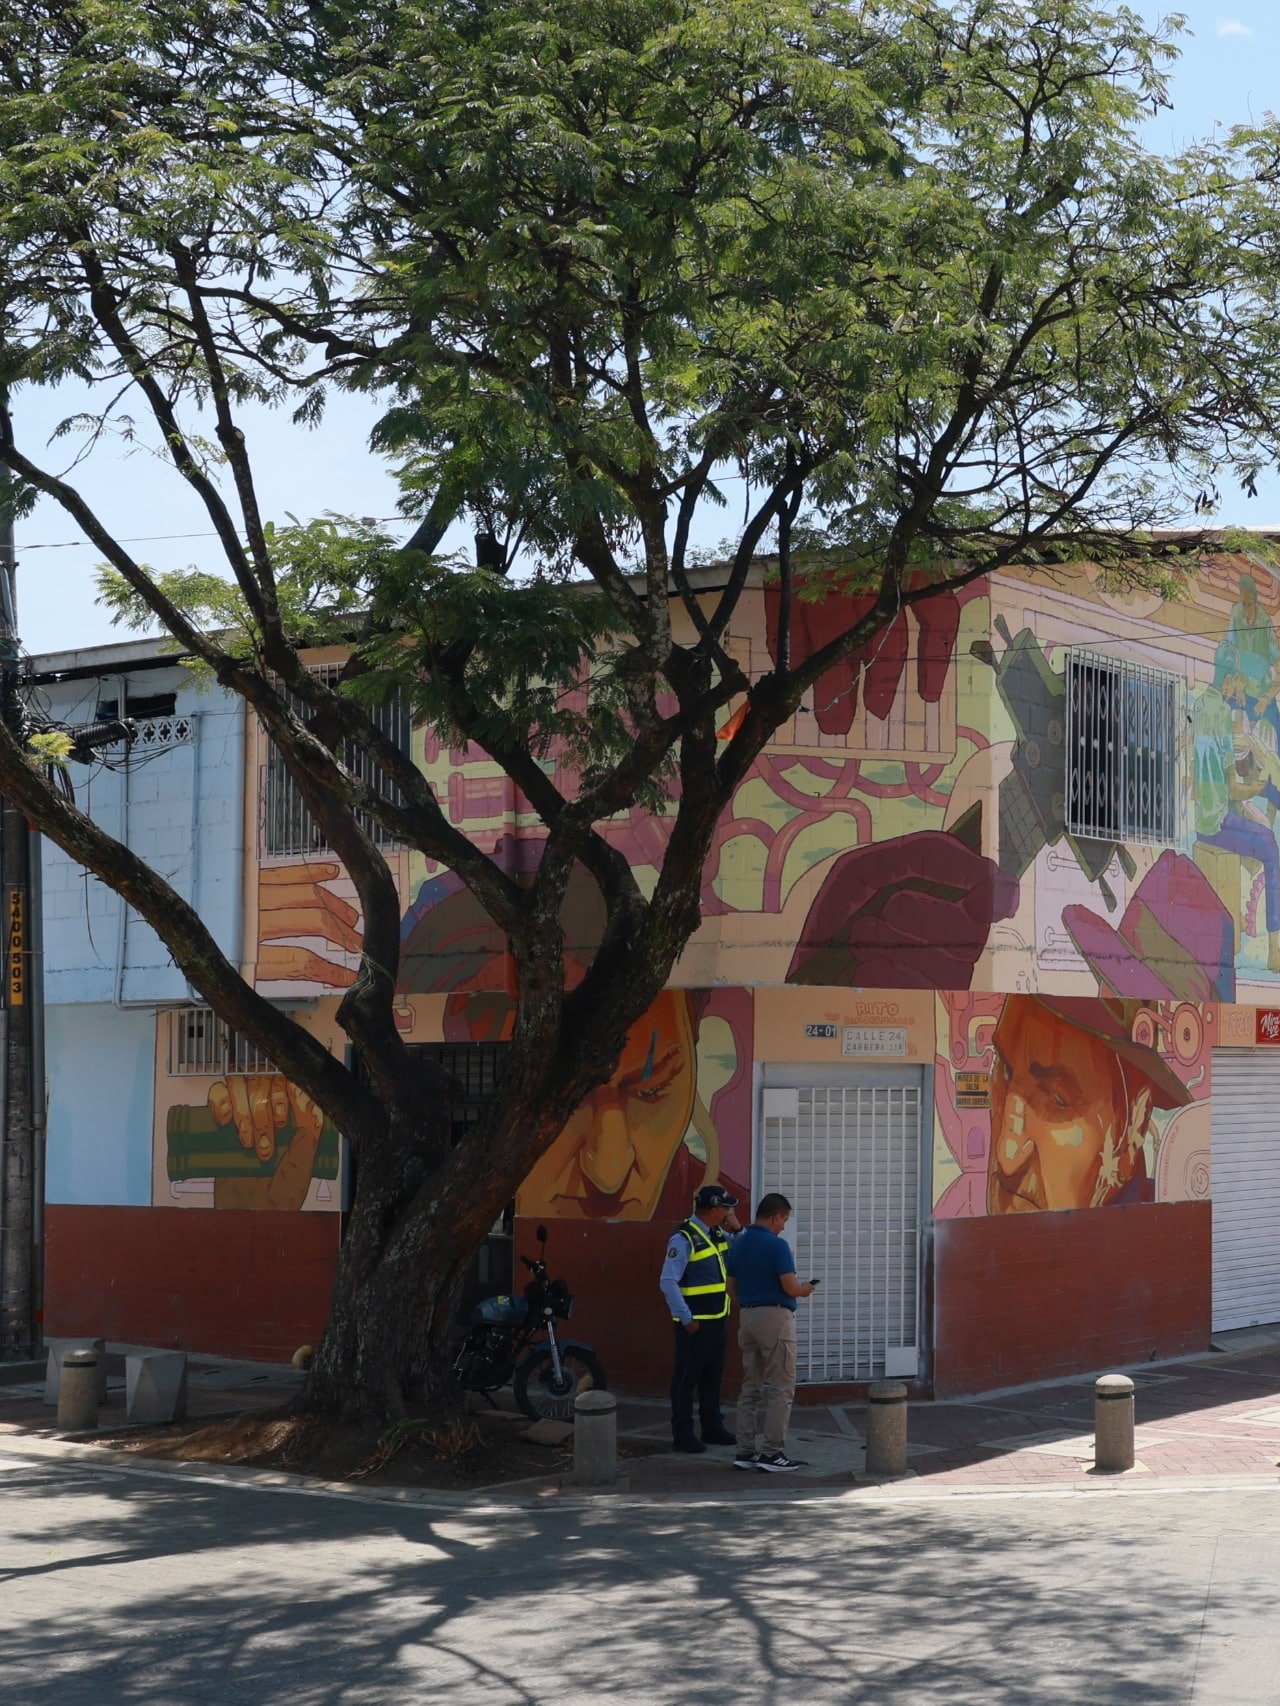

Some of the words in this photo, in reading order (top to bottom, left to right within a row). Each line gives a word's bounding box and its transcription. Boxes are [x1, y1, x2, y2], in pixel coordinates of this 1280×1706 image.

[855, 1001, 899, 1016] RITO
[806, 1025, 837, 1037] 24-01
[846, 1031, 885, 1041] CALLE
[889, 1031, 902, 1041] 24
[846, 1043, 886, 1051] CARRERA
[958, 1074, 972, 1082] MUSEO
[974, 1075, 981, 1083] DE
[983, 1075, 989, 1083] LA
[956, 1097, 971, 1106] BARRIO
[972, 1097, 989, 1106] OBRERO
